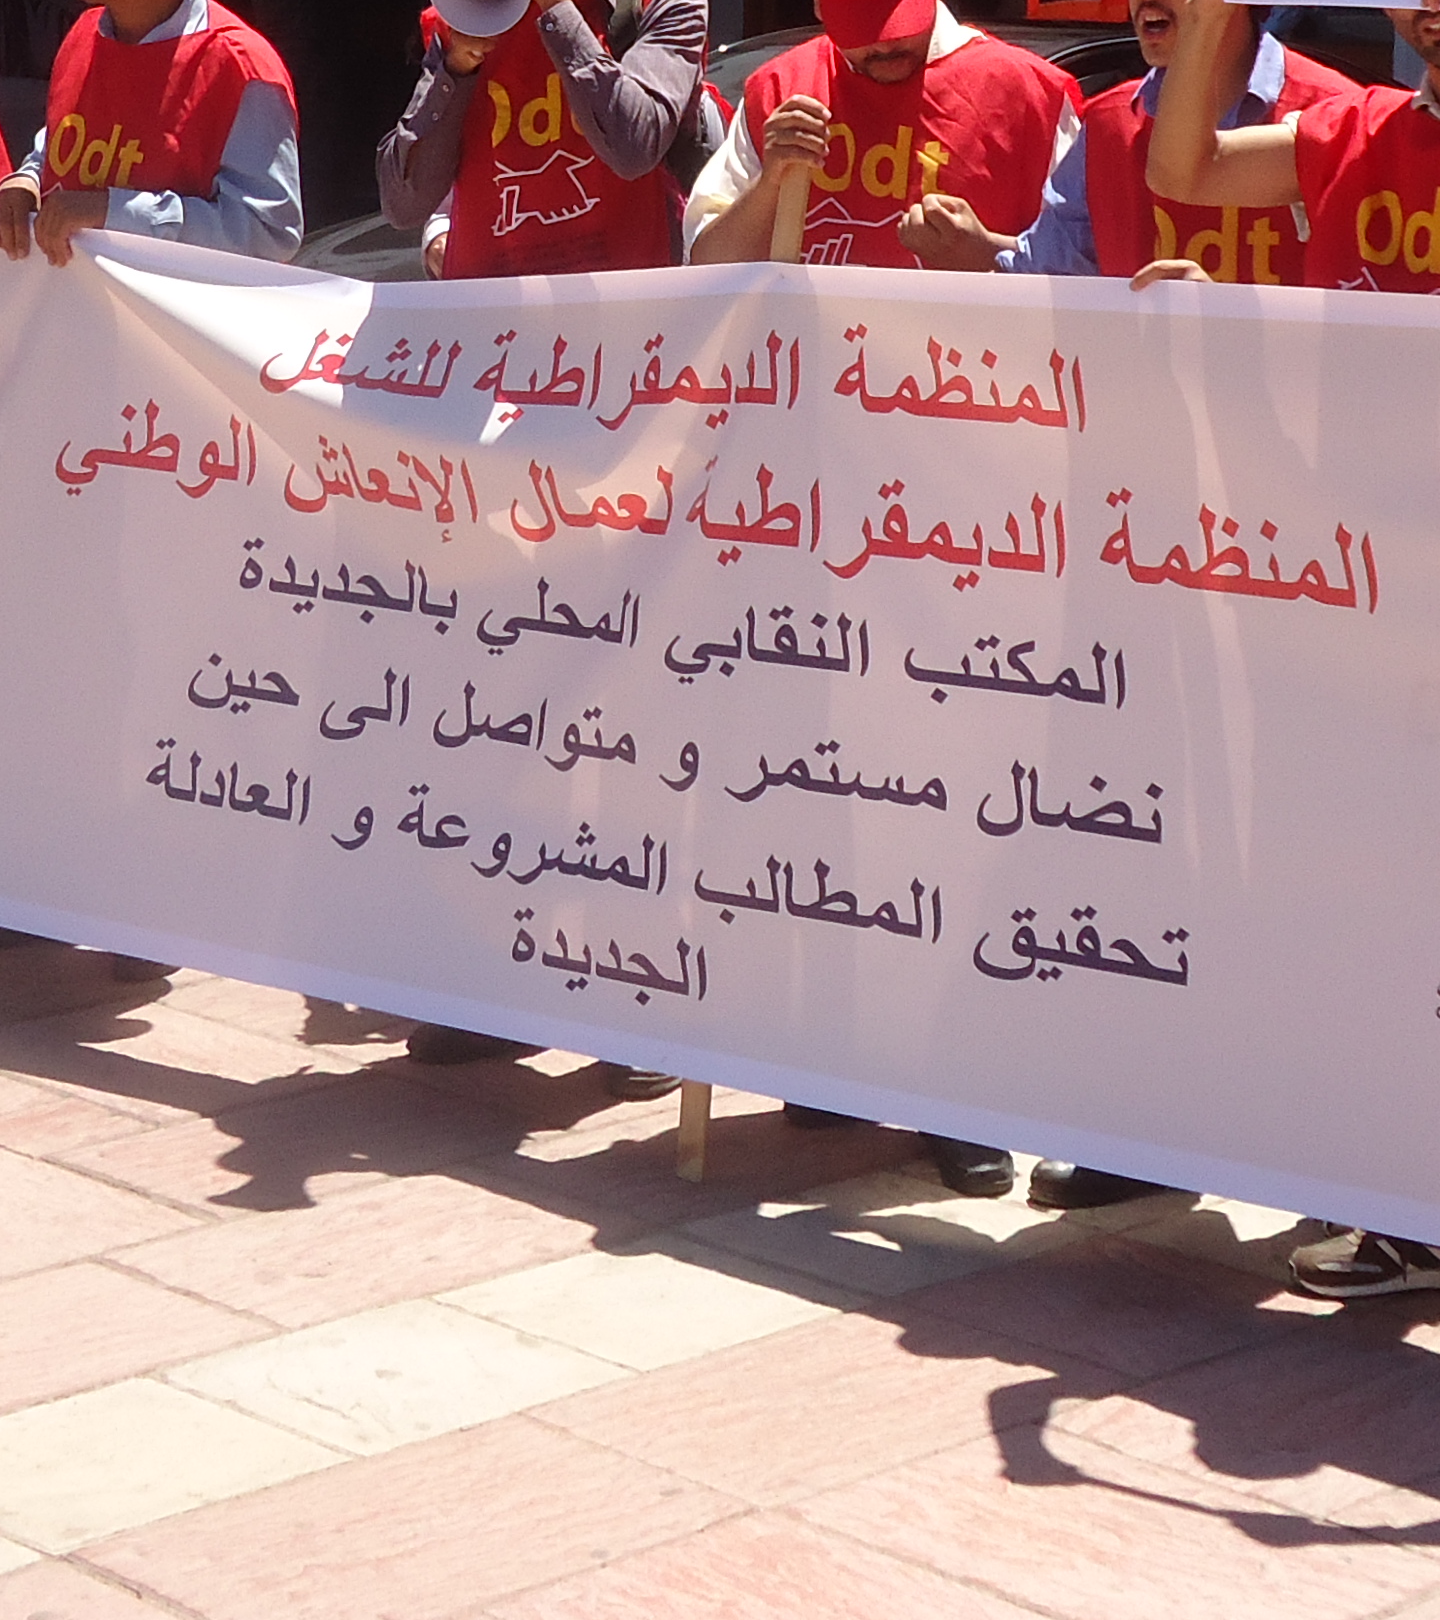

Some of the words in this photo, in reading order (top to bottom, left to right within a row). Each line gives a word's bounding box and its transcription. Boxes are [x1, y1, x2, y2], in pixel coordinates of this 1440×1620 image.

[47, 112, 145, 189] Odt
[811, 122, 951, 201] Odt
[259, 328, 462, 400] للشغل
[475, 329, 802, 431] الديمقراطية
[834, 322, 1088, 431] المنظمة
[55, 399, 258, 500] الوطني
[284, 436, 479, 544] الإنعاش
[509, 461, 676, 544] لعمال
[687, 454, 1068, 593] الديمقراطية
[238, 537, 459, 635] بالجديدة
[1100, 487, 1380, 614] المنظمة
[475, 575, 642, 657] المحلي
[663, 604, 870, 686] النقابي
[186, 651, 301, 716] حين
[318, 666, 411, 742] الى
[903, 633, 1127, 711] المكتب
[431, 680, 638, 773] متواصل
[657, 740, 701, 793] و
[144, 736, 312, 827] العادلة
[722, 738, 949, 813] مستمر
[975, 758, 1165, 845] نضال
[329, 805, 375, 852] و
[395, 782, 668, 897] المشروعة
[693, 853, 943, 945] المطالب
[510, 906, 708, 1007] الجديدة
[971, 904, 1191, 988] تحقيق
